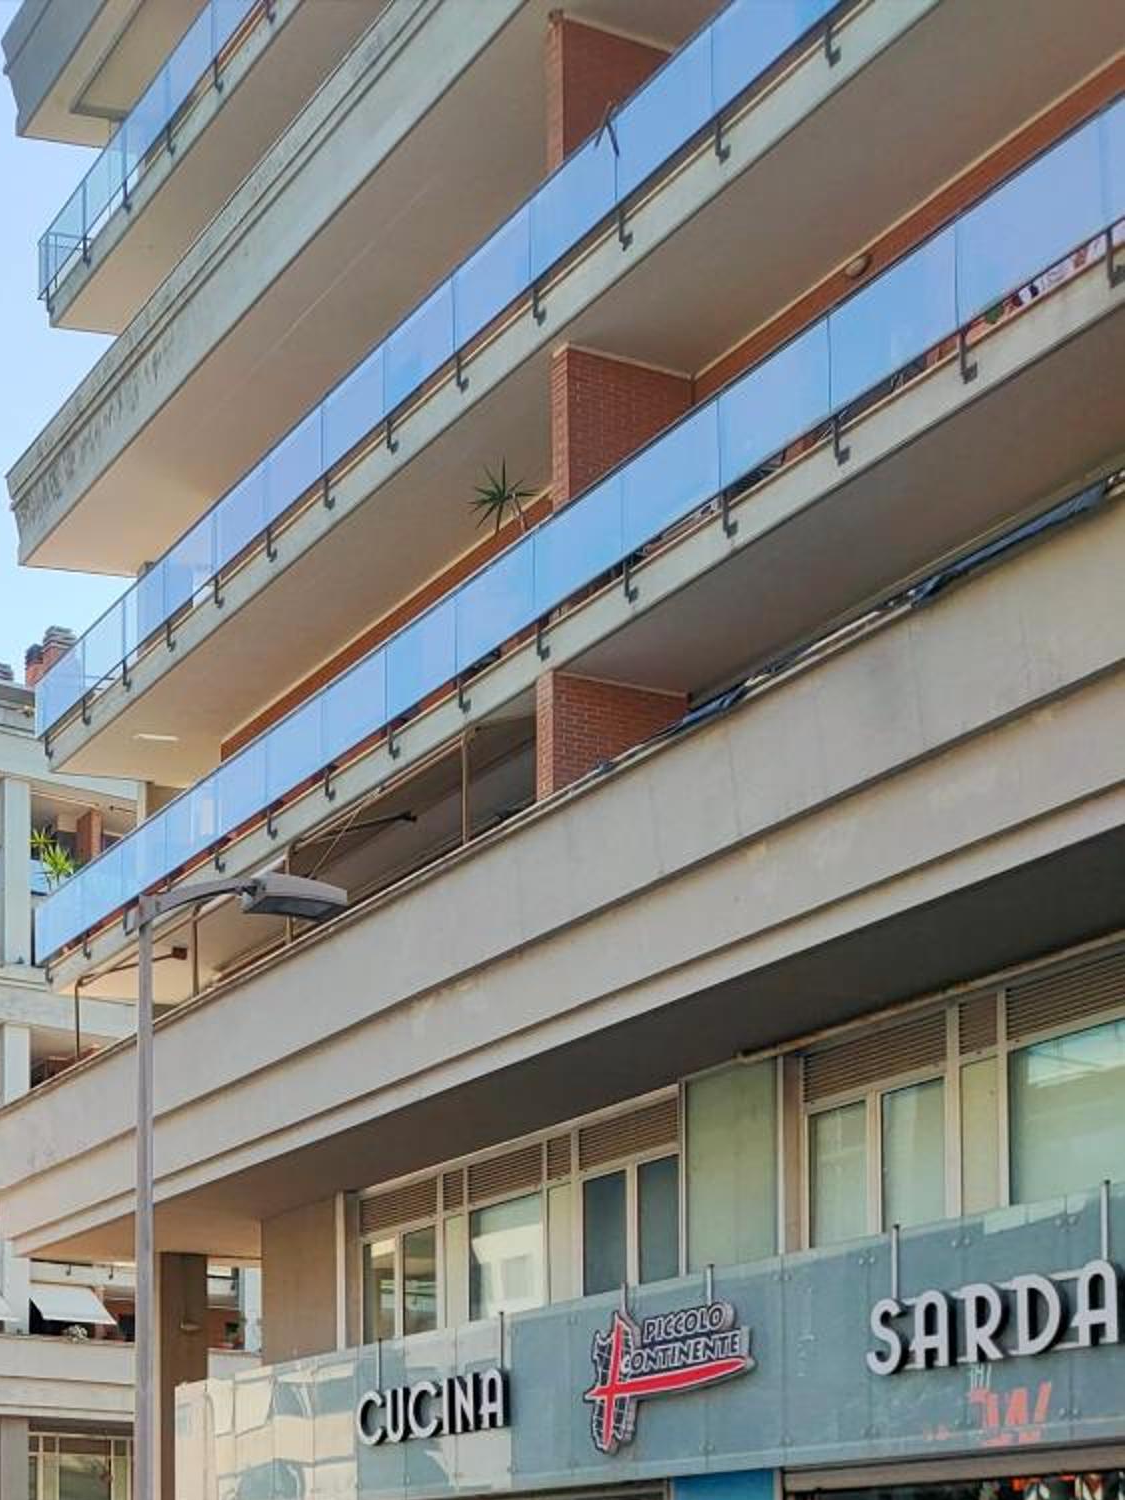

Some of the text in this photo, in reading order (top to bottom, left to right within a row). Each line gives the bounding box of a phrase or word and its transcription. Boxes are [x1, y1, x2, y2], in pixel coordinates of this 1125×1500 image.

[643, 1303, 726, 1343] PICCOLO
[866, 1259, 1120, 1376] SARDA
[621, 1330, 742, 1374] CONTINENTE
[356, 1367, 509, 1446] CUCINA
